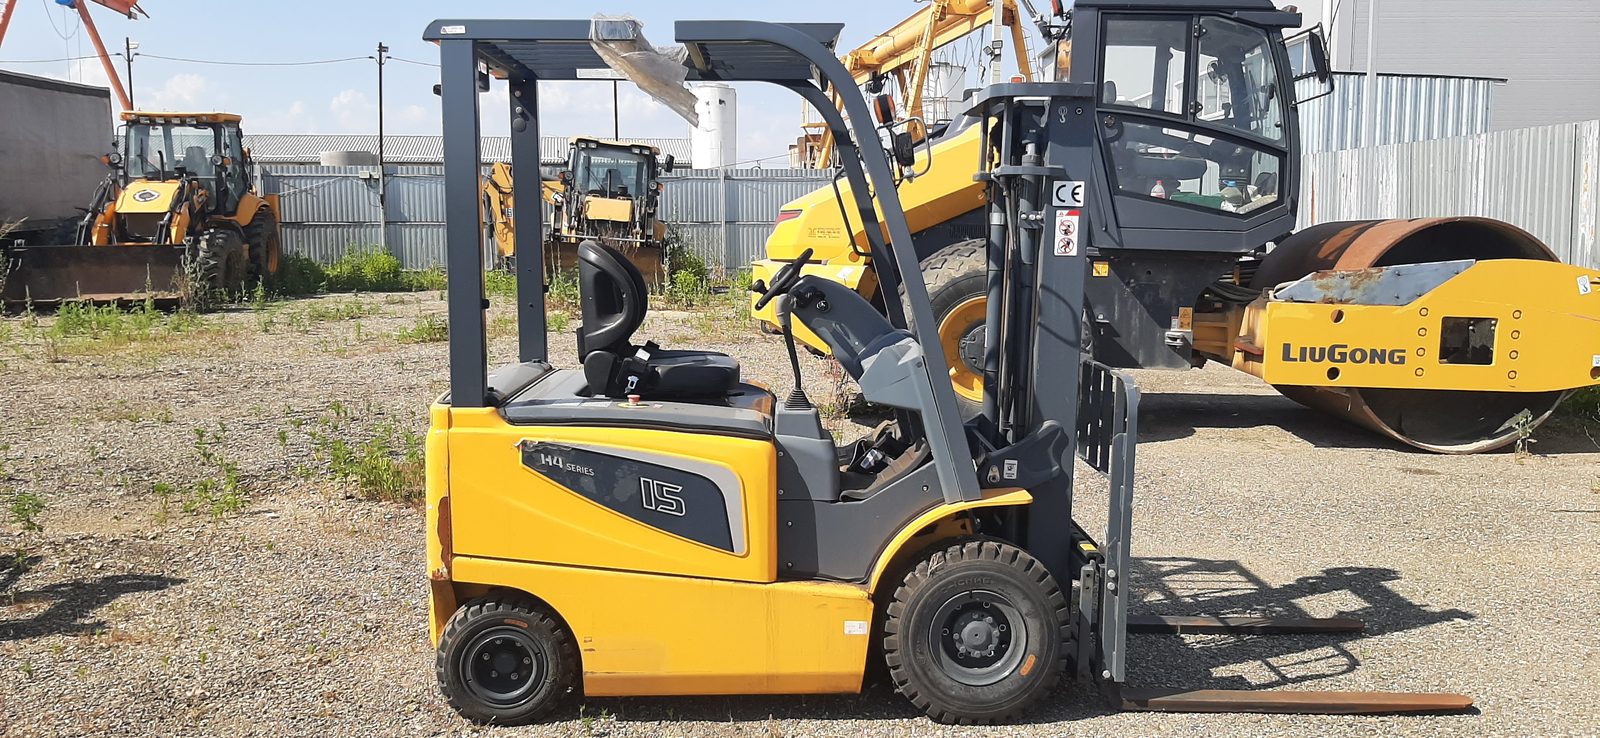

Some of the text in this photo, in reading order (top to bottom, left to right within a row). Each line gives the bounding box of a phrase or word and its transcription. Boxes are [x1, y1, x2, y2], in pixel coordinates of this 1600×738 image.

[1056, 184, 1082, 203] CE
[540, 453, 595, 476] H4 SERIES
[640, 477, 686, 517] 15
